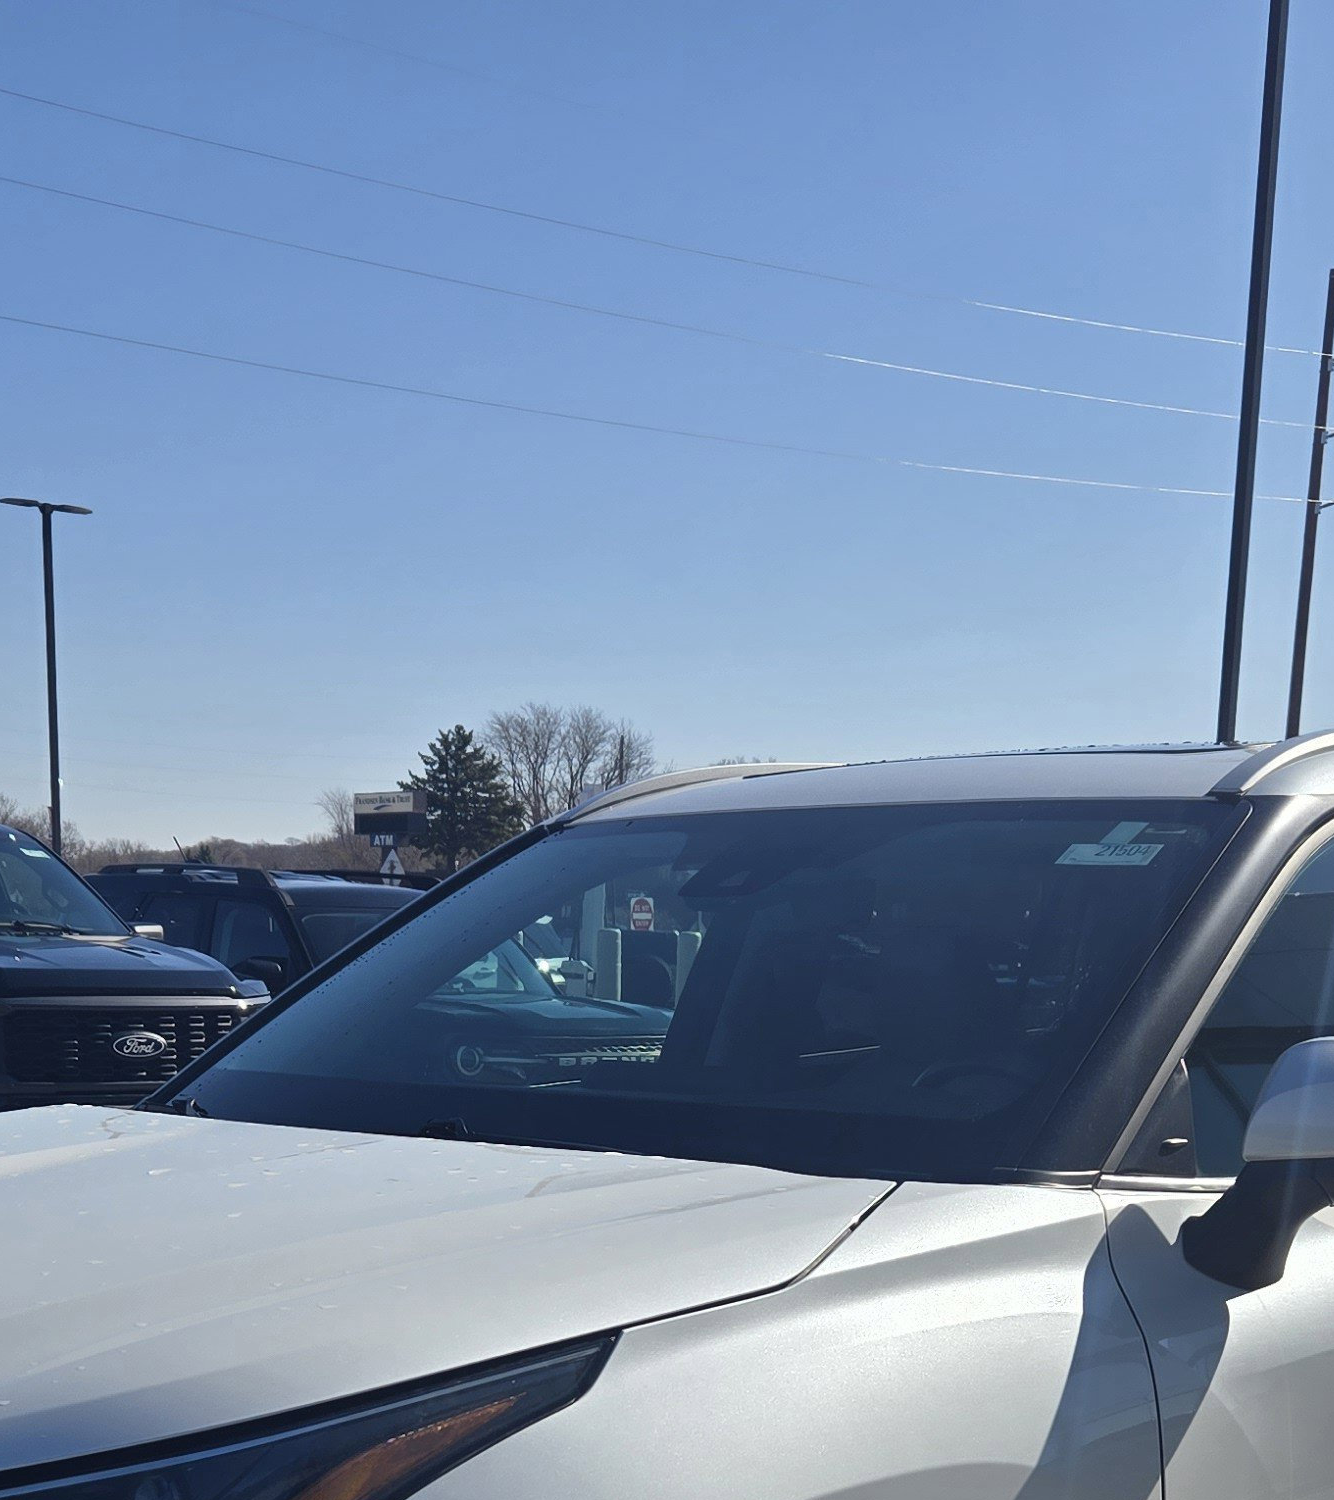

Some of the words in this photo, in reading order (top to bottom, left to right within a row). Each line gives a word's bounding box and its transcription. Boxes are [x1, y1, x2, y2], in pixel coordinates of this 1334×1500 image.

[373, 834, 394, 846] ATM
[1094, 844, 1150, 857] 21504
[123, 1038, 155, 1053] Ford
